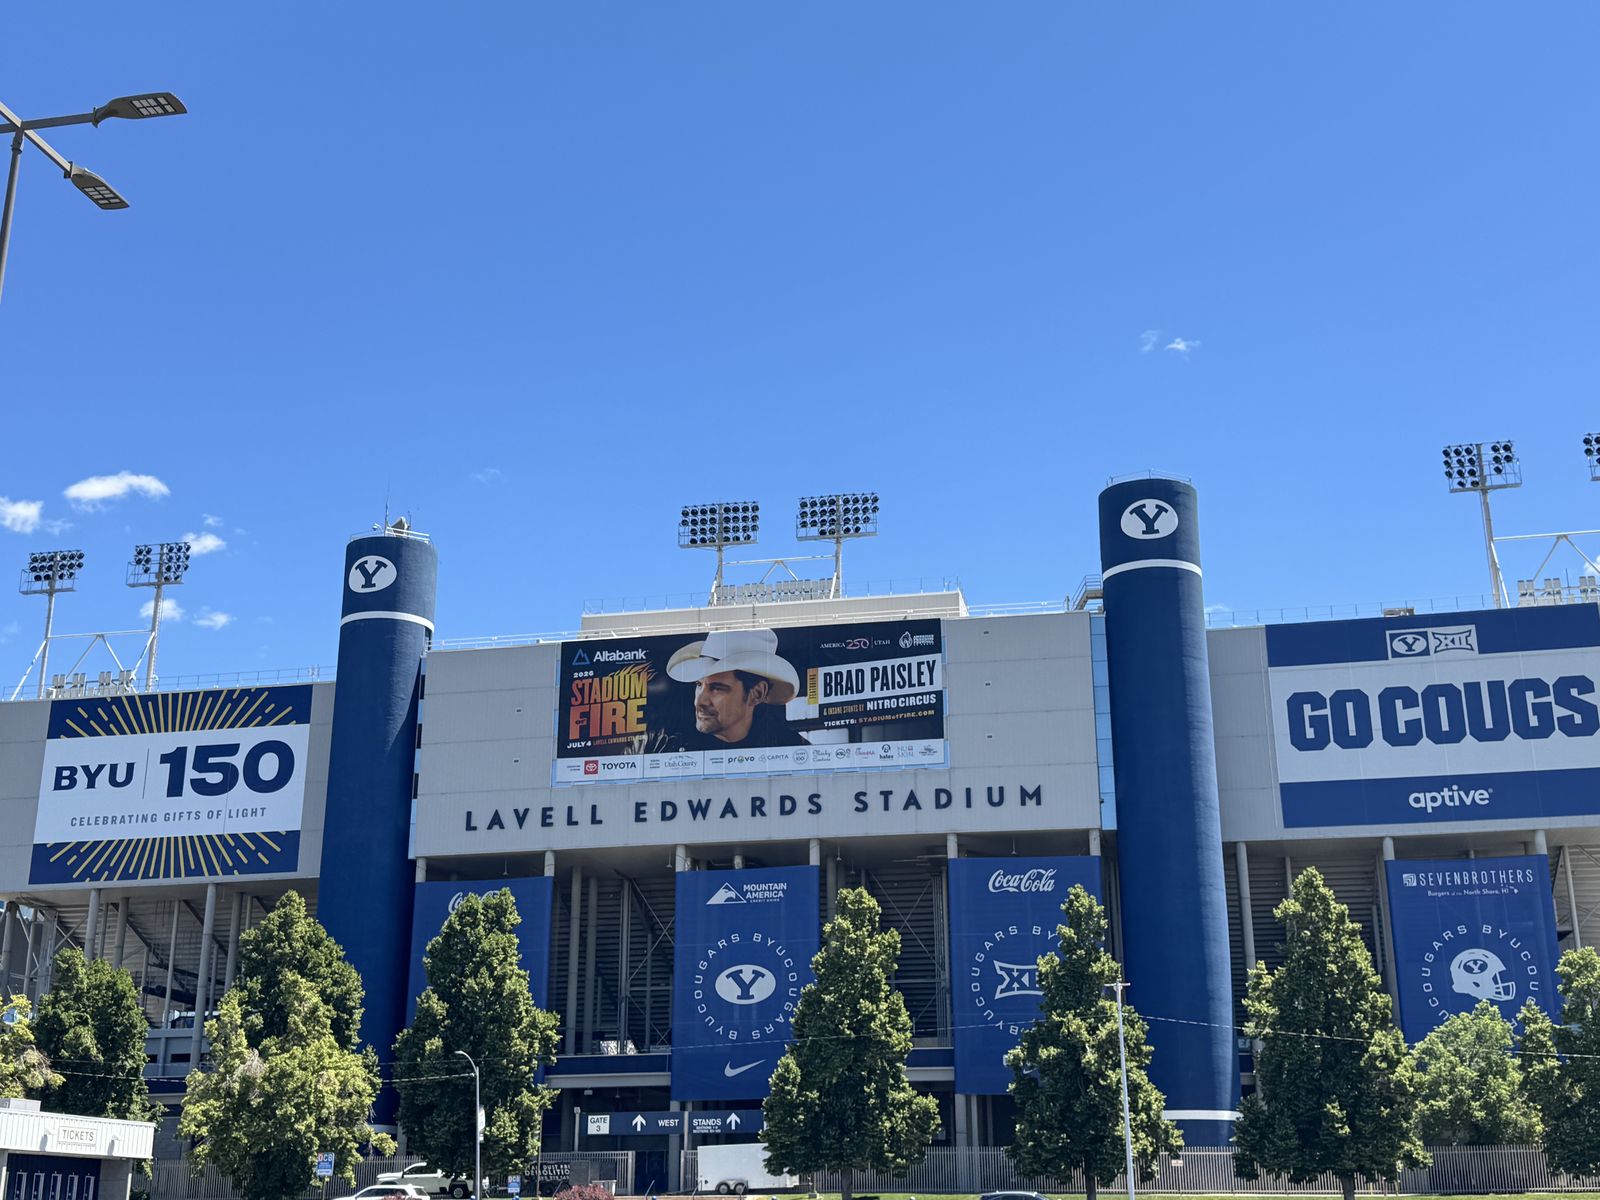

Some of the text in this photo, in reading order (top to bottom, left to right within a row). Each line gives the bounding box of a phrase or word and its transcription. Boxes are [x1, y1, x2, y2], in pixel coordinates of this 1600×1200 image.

[846, 638, 870, 650] 250
[593, 648, 647, 662] Altabank
[573, 670, 594, 678] 2026
[823, 660, 937, 698] BRAD PAISLEY
[570, 671, 648, 706] STADIUM
[866, 699, 897, 711] NITRO
[898, 694, 936, 707] CIRCUS
[568, 698, 647, 740] FIRE
[1286, 674, 1600, 752] GO COUGS
[567, 741, 587, 749] JULY
[52, 739, 296, 798] BYU 150
[602, 761, 637, 770] TOYOTA
[1408, 784, 1490, 813] aptive
[465, 784, 1043, 831] LAVELL EDWARDS STADIUM
[70, 806, 267, 827] CELEBRATING GIFTS OF LIGHT
[988, 868, 1058, 893] Coca-Cola
[1419, 868, 1533, 887] SEVENBROTHERS
[743, 882, 787, 892] MOUNTAIN
[745, 890, 784, 899] AMERICA
[589, 1116, 608, 1124] GATE
[658, 1118, 722, 1127] WEST STANDS
[62, 1129, 95, 1142] TICKETS
